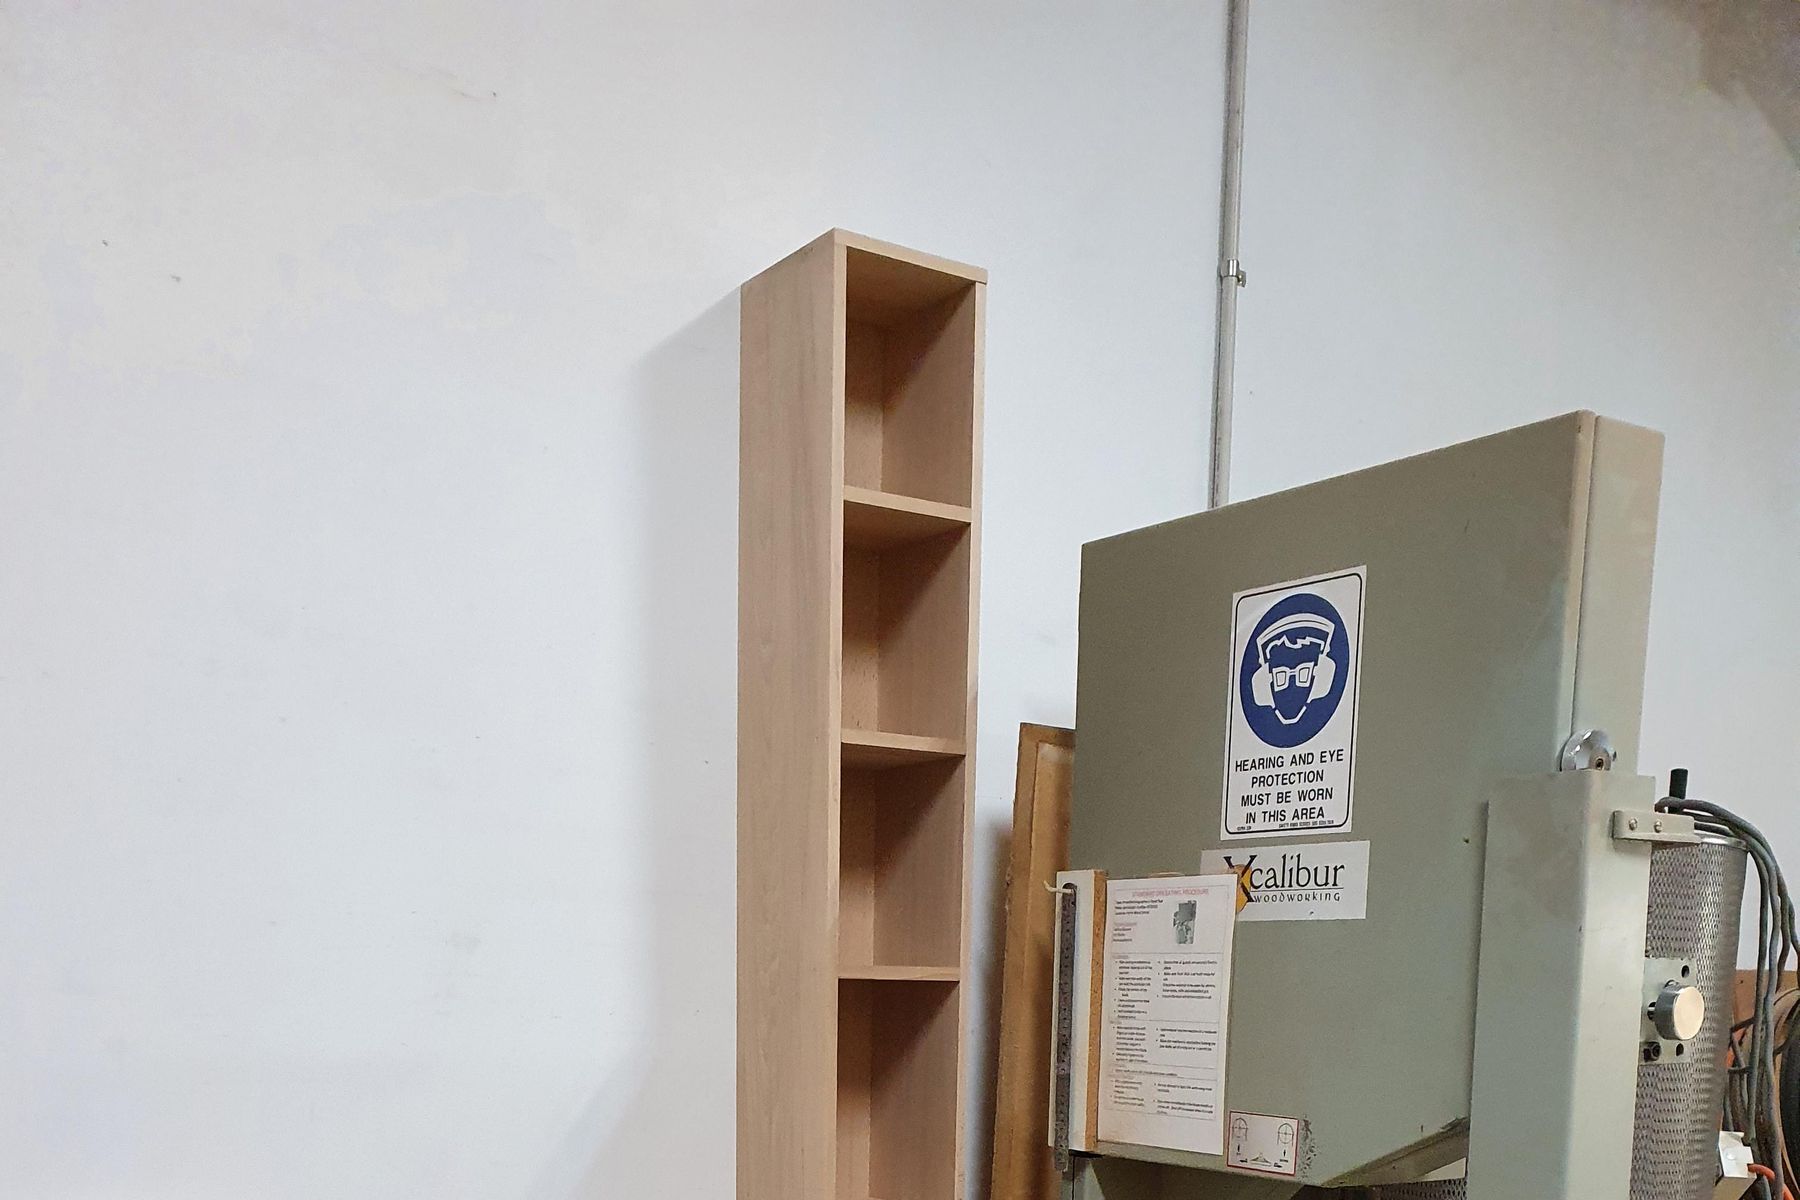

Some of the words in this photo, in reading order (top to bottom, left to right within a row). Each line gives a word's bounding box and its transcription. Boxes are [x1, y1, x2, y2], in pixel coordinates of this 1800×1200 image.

[1235, 755, 1285, 772] HEARING
[1289, 752, 1315, 767] AND
[1319, 748, 1344, 764] EYE
[1251, 769, 1324, 788] PROTECTION
[1240, 792, 1272, 807] MUST
[1276, 790, 1292, 804] BE
[1297, 787, 1333, 802] WORN
[1245, 811, 1256, 824] IN
[1261, 809, 1287, 823] THIS
[1291, 806, 1325, 821] AREA
